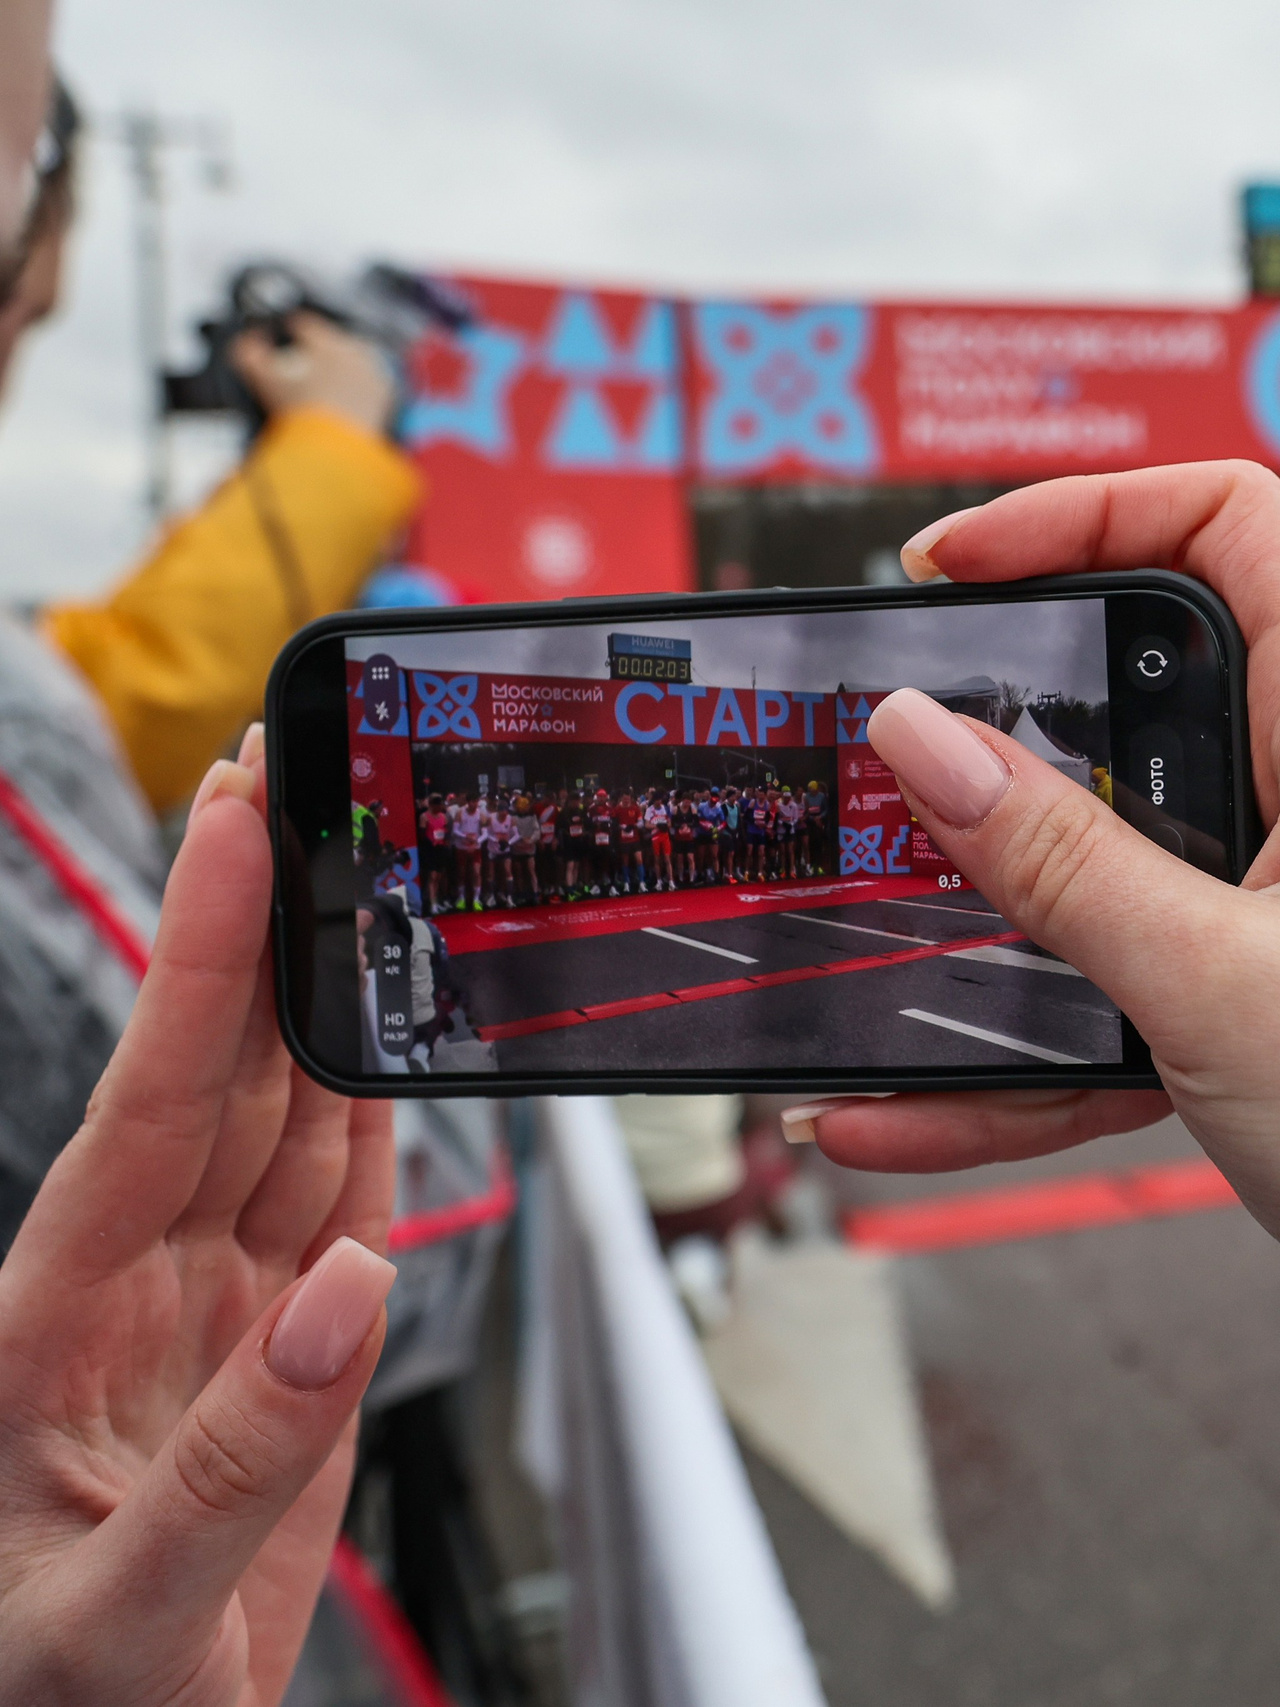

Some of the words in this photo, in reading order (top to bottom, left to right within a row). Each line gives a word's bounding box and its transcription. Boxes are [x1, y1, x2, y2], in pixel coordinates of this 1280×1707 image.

[631, 636, 675, 649] HUAWEI
[491, 683, 603, 702] МОСКОВСКИЙ
[492, 702, 539, 716] ПОЛУ
[615, 681, 824, 746] СТАРТ
[493, 718, 576, 733] МАРАФОН
[1150, 757, 1165, 805] ФОТО
[938, 875, 961, 890] 0,5
[383, 945, 401, 959] 30
[384, 1013, 405, 1026] HD
